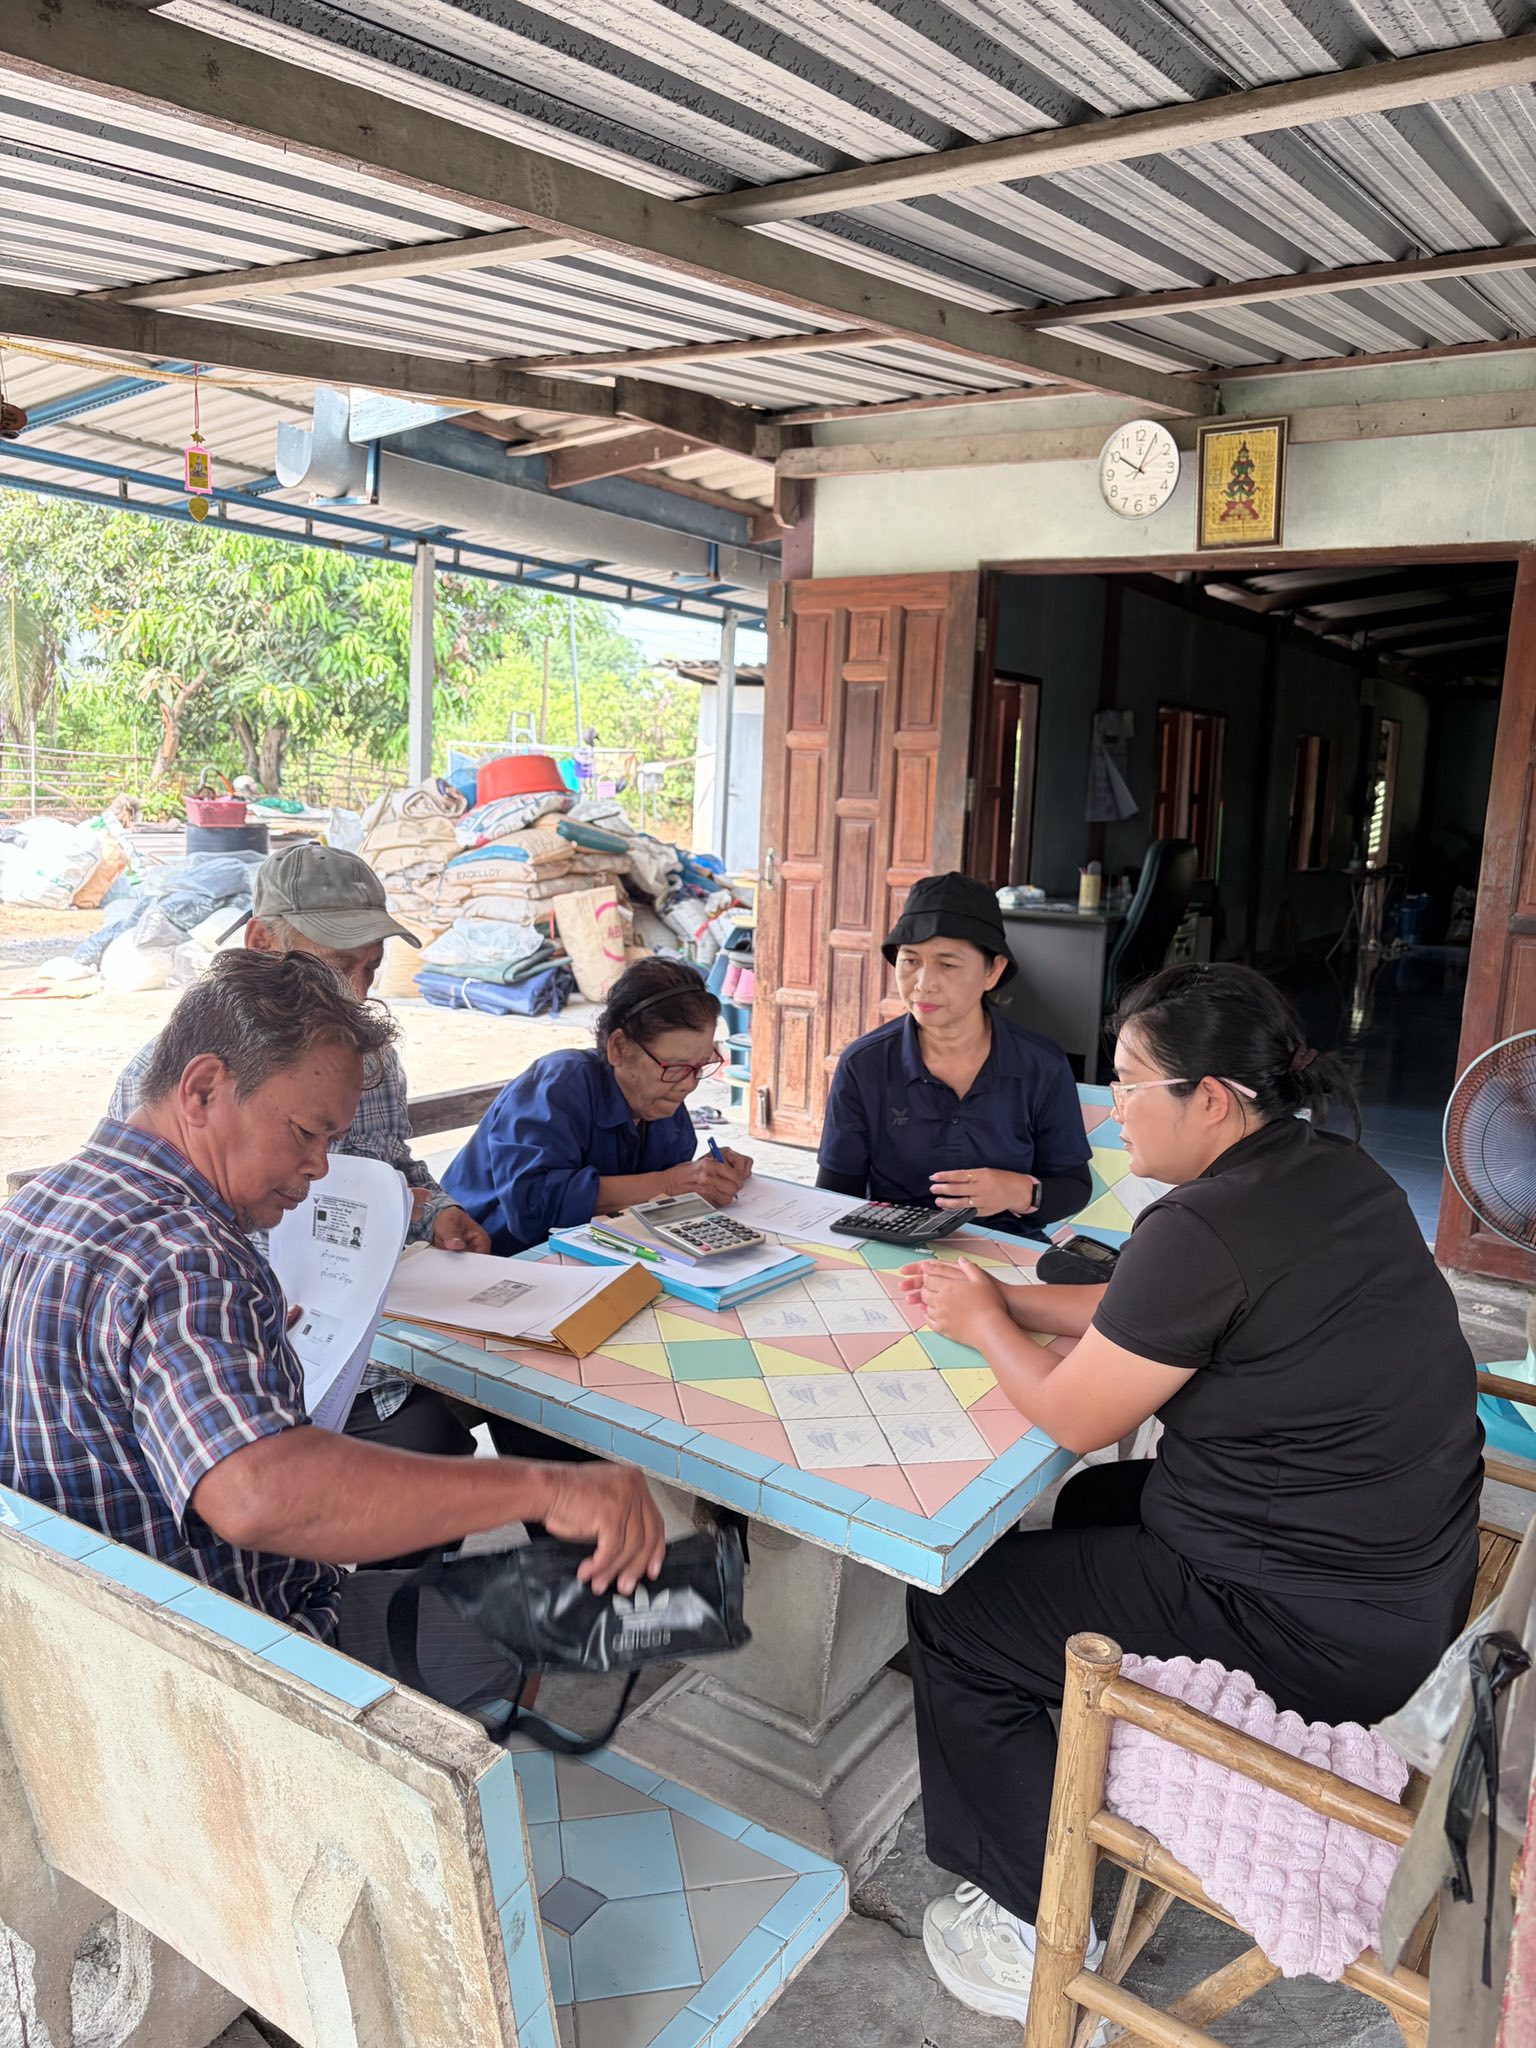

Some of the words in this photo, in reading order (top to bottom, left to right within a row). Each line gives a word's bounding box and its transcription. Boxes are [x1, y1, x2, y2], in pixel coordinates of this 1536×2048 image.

[1135, 429, 1146, 442] 12
[1121, 437, 1129, 449] 11
[1162, 442, 1171, 456] 2
[1110, 450, 1121, 463] 10
[1166, 462, 1175, 474] 3
[1106, 469, 1115, 481] 9
[1160, 479, 1169, 490] 4
[1110, 485, 1118, 497] 8
[1121, 497, 1129, 509] 7
[1134, 499, 1143, 512] 6
[1149, 494, 1158, 507] 5
